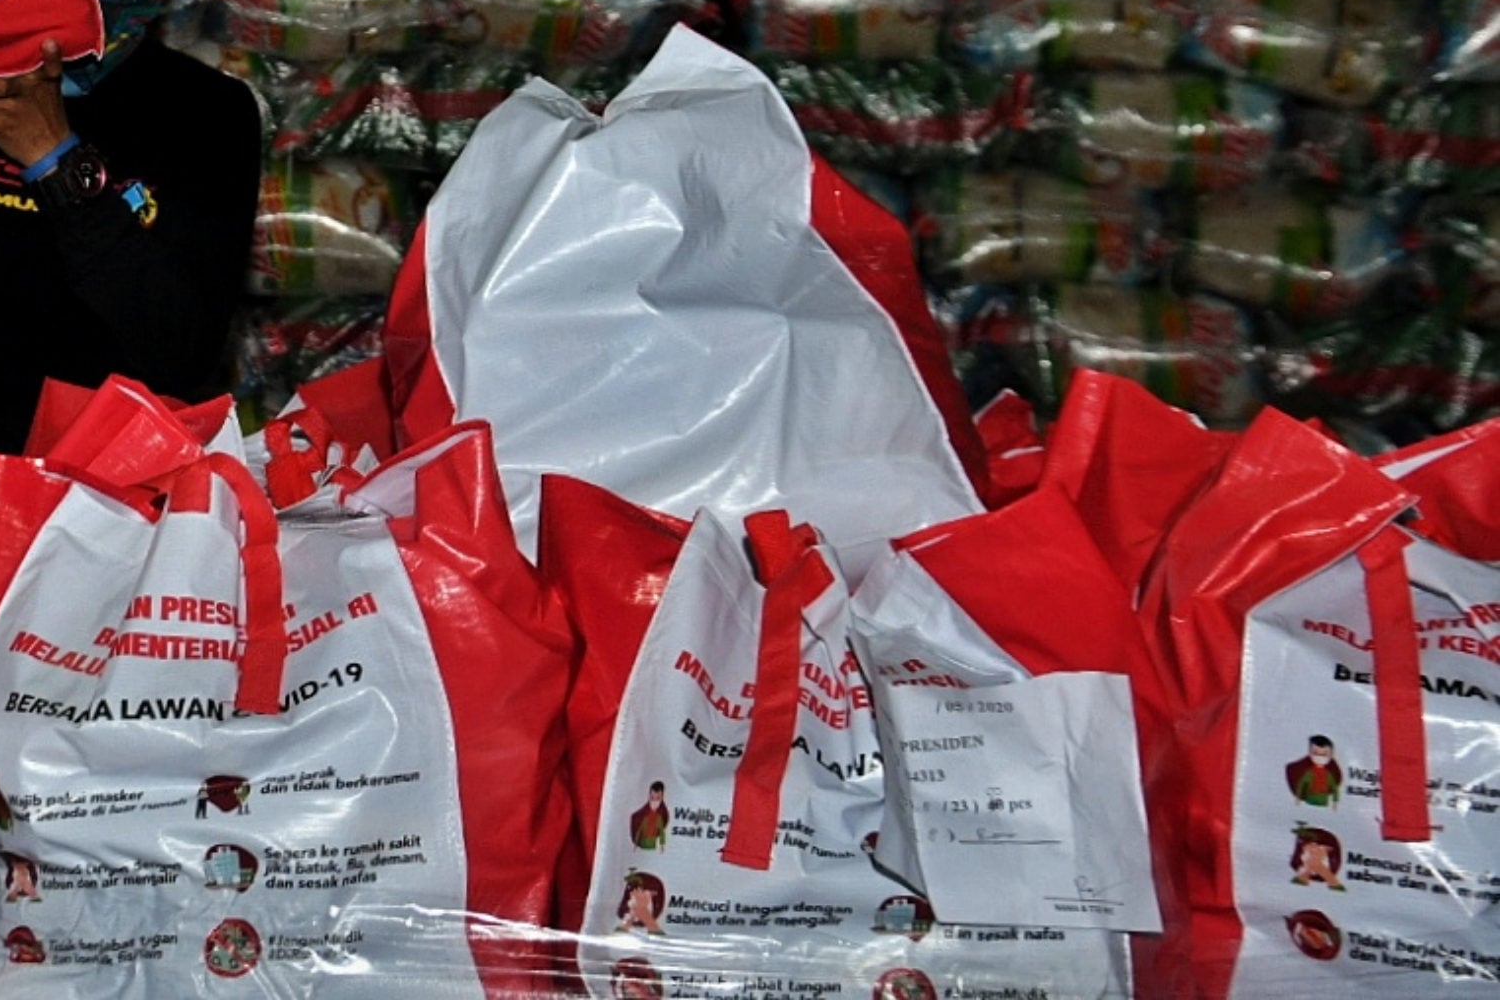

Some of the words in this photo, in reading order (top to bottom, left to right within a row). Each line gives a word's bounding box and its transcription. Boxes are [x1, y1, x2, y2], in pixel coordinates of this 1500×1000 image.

[347, 592, 378, 619] RI
[120, 698, 225, 722] LAWAN
[900, 734, 985, 753] PRESIDEN
[668, 894, 731, 914] Mencuci
[735, 902, 790, 919] tangan
[665, 910, 712, 926] sabun
[716, 913, 746, 927] dan
[1023, 926, 1066, 941] nafas
